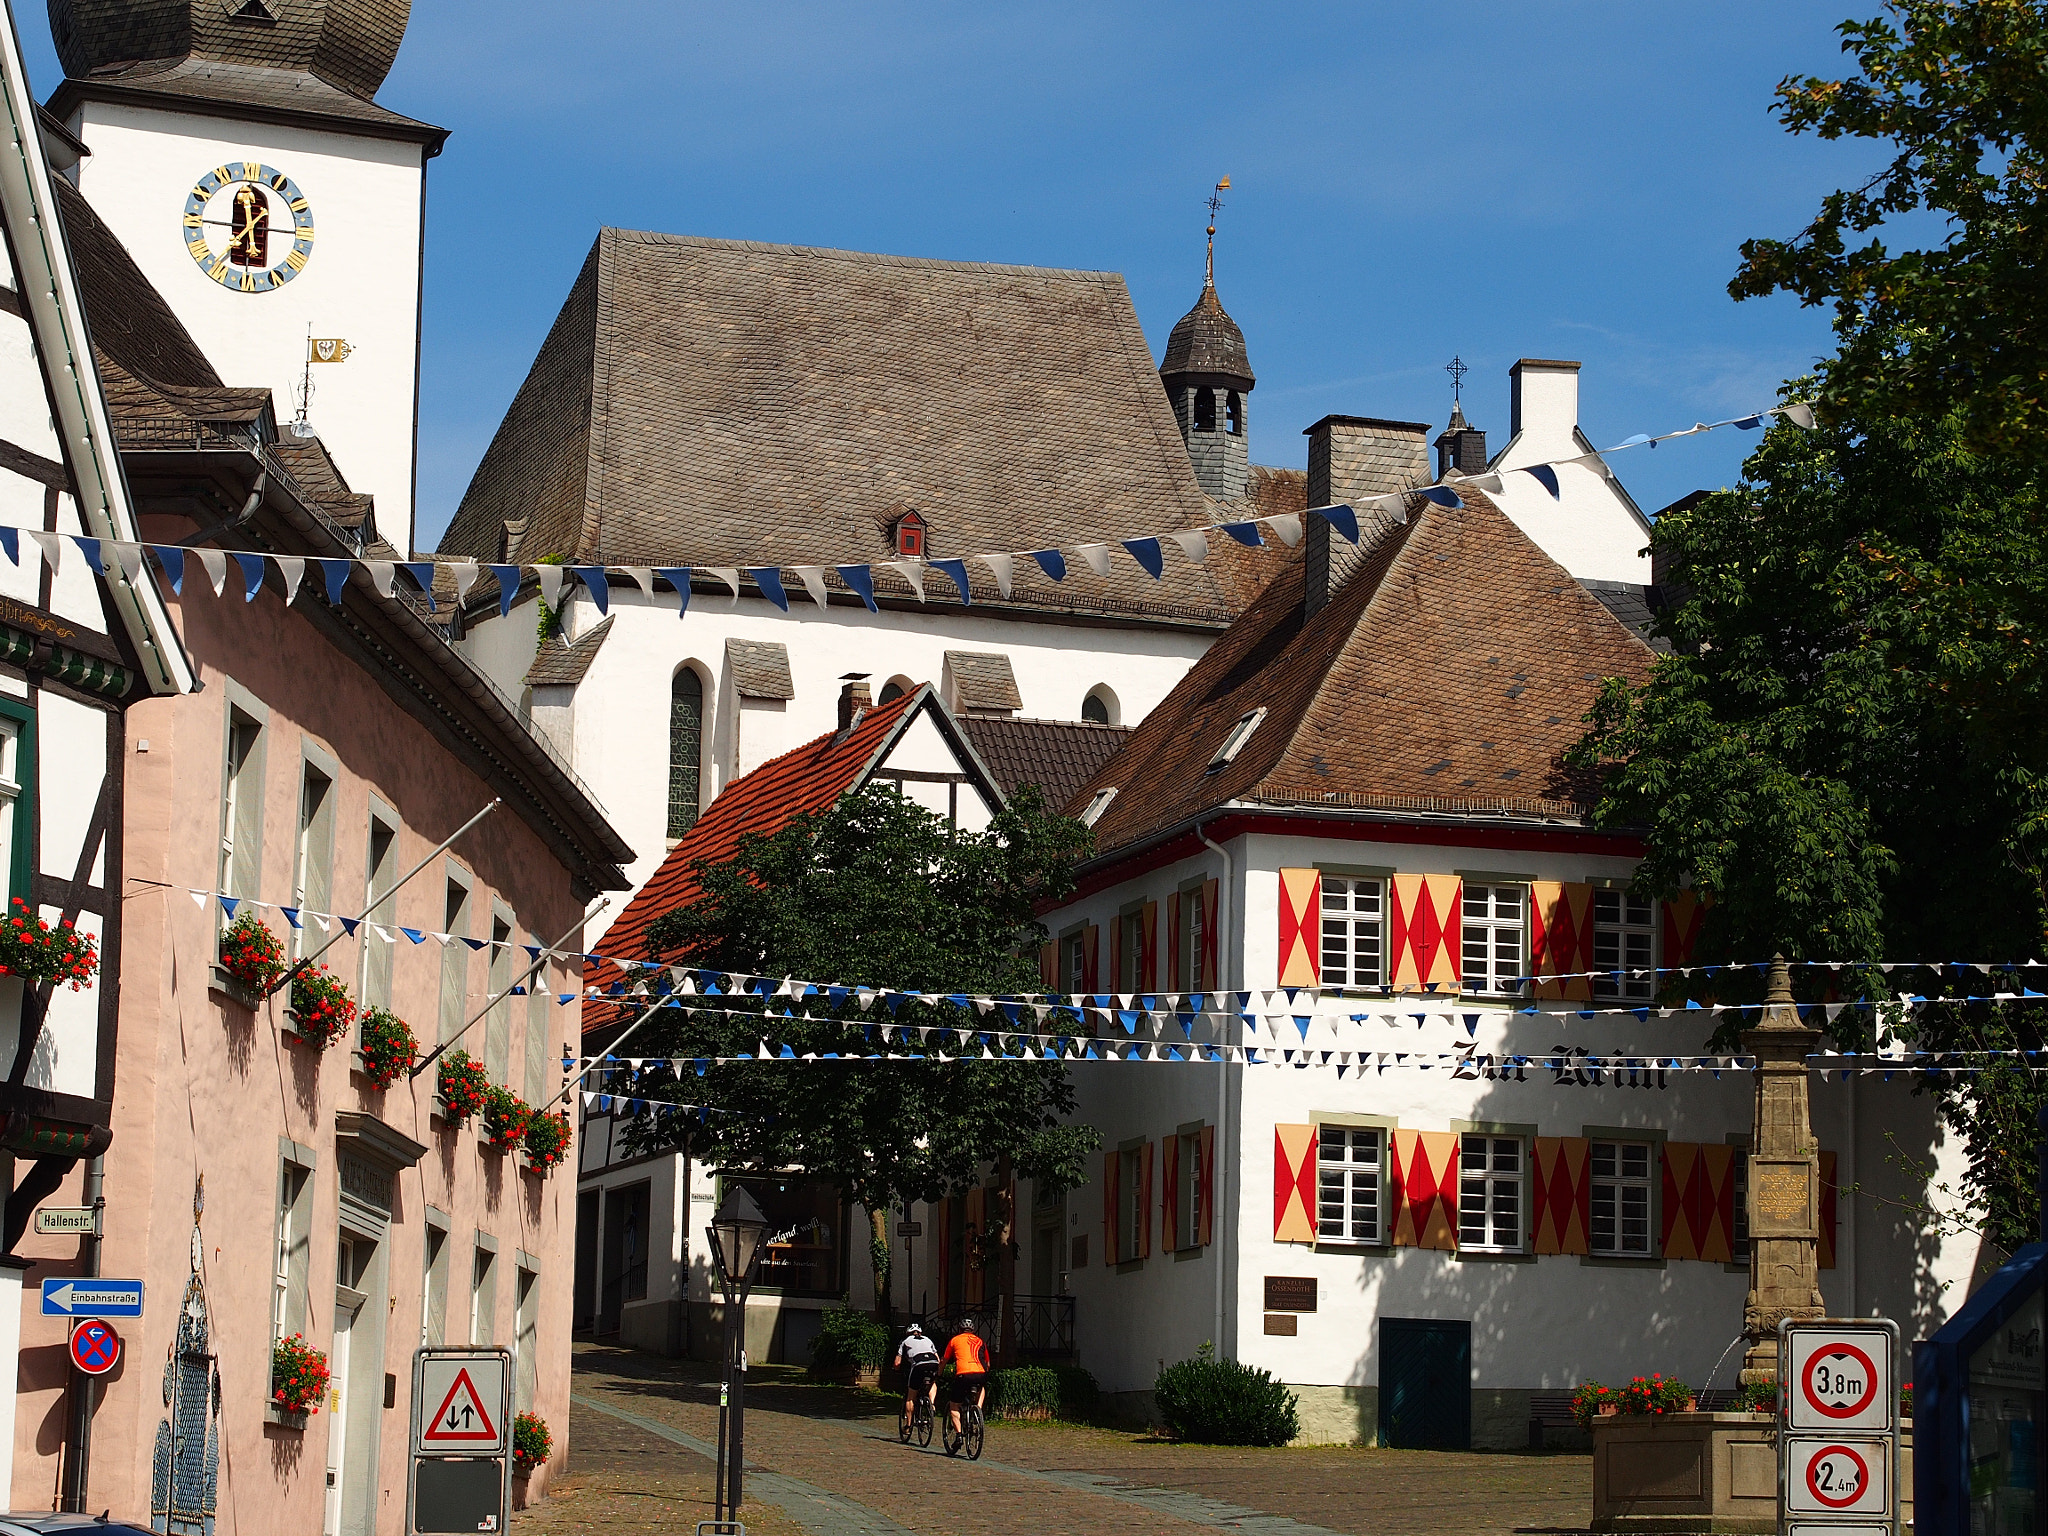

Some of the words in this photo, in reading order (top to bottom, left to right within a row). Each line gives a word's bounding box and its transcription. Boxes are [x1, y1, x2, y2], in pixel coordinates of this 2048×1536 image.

[1450, 1041, 1531, 1082] Zur
[1551, 1044, 1668, 1090] Krim
[44, 1213, 90, 1227] Hallenstr.
[71, 1293, 136, 1303] Einbahnstraße
[1817, 1366, 1861, 1395] 3,8m
